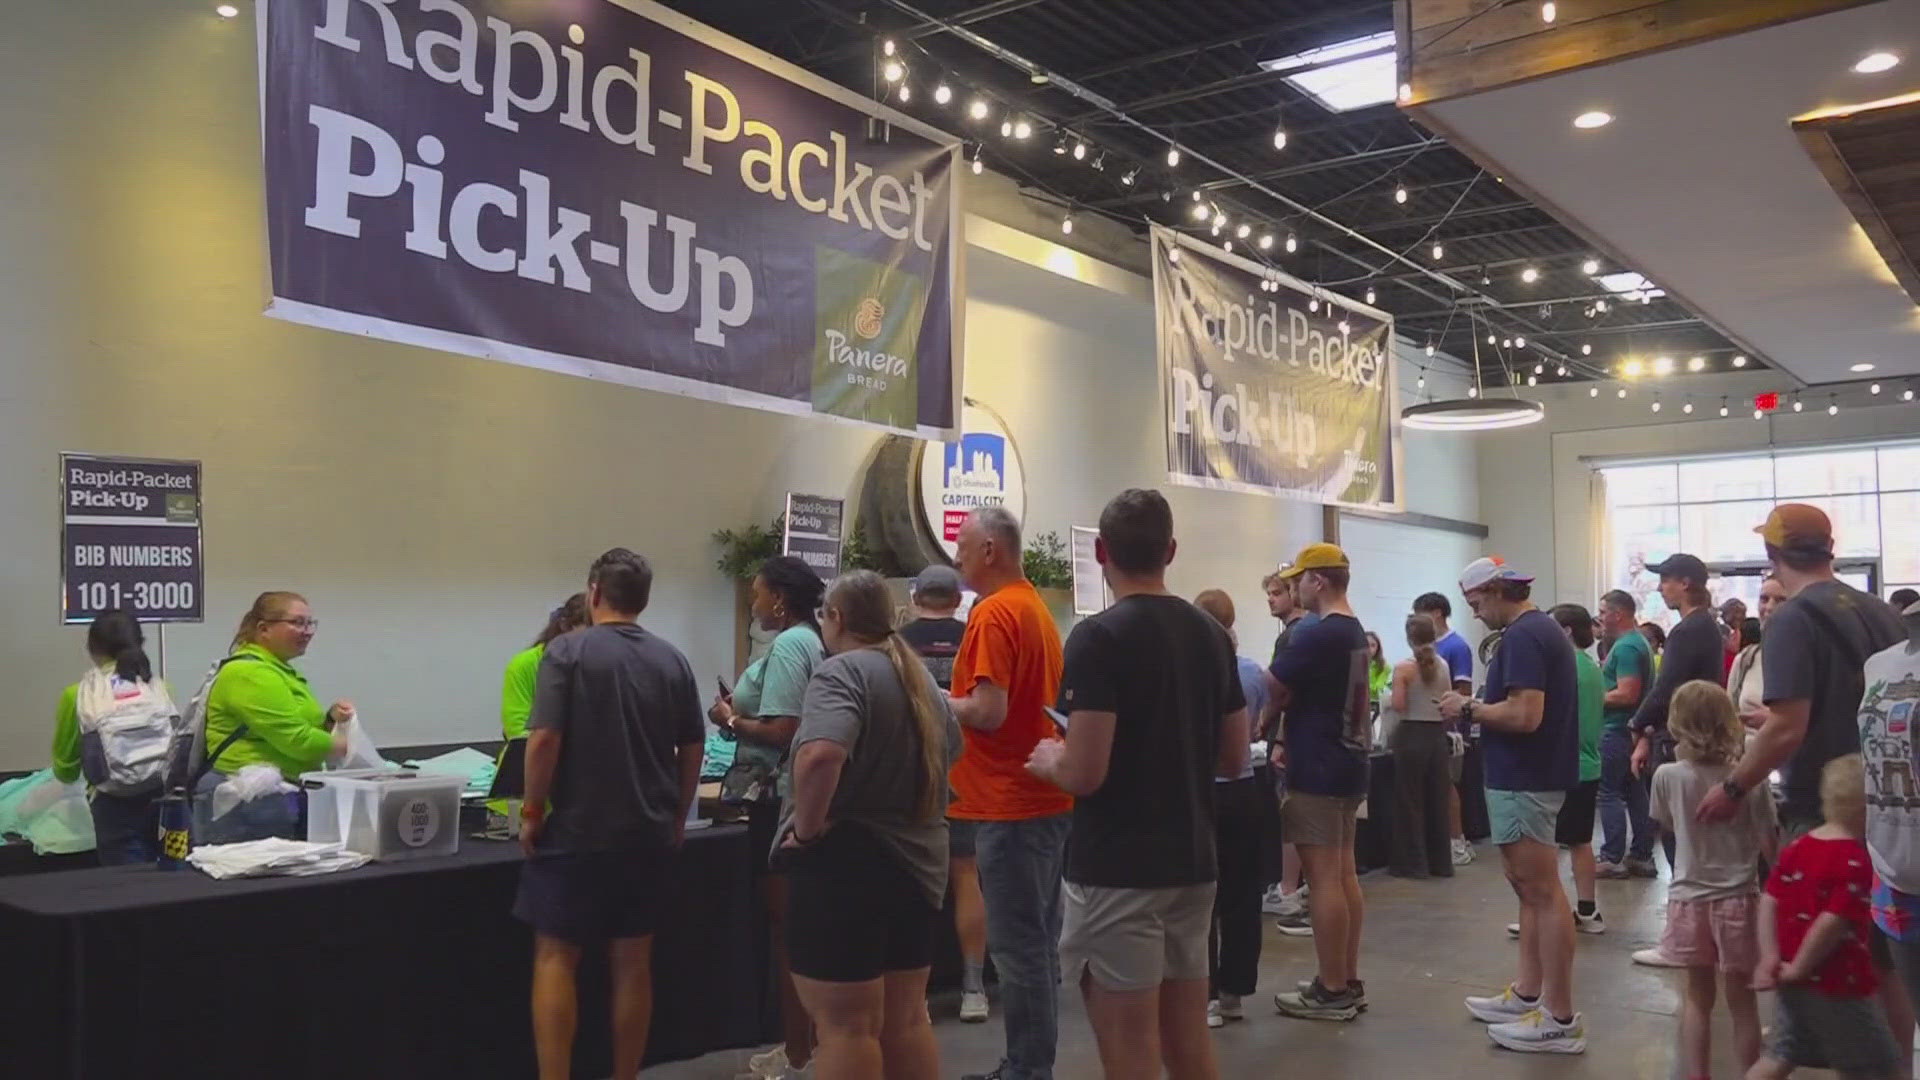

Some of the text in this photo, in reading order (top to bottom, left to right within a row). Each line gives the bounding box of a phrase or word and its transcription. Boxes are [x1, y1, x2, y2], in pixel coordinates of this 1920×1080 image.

[305, 104, 754, 348] Pick-Up
[825, 329, 907, 379] Panera
[847, 373, 887, 392] BREAD
[1172, 367, 1317, 469] Pick-Up
[70, 468, 192, 489] Rapid-Packet
[70, 490, 149, 511] Pick-Up
[789, 514, 822, 529] Pick-Up
[74, 545, 192, 567] BIB NUMBERS
[78, 582, 193, 610] 101-3000
